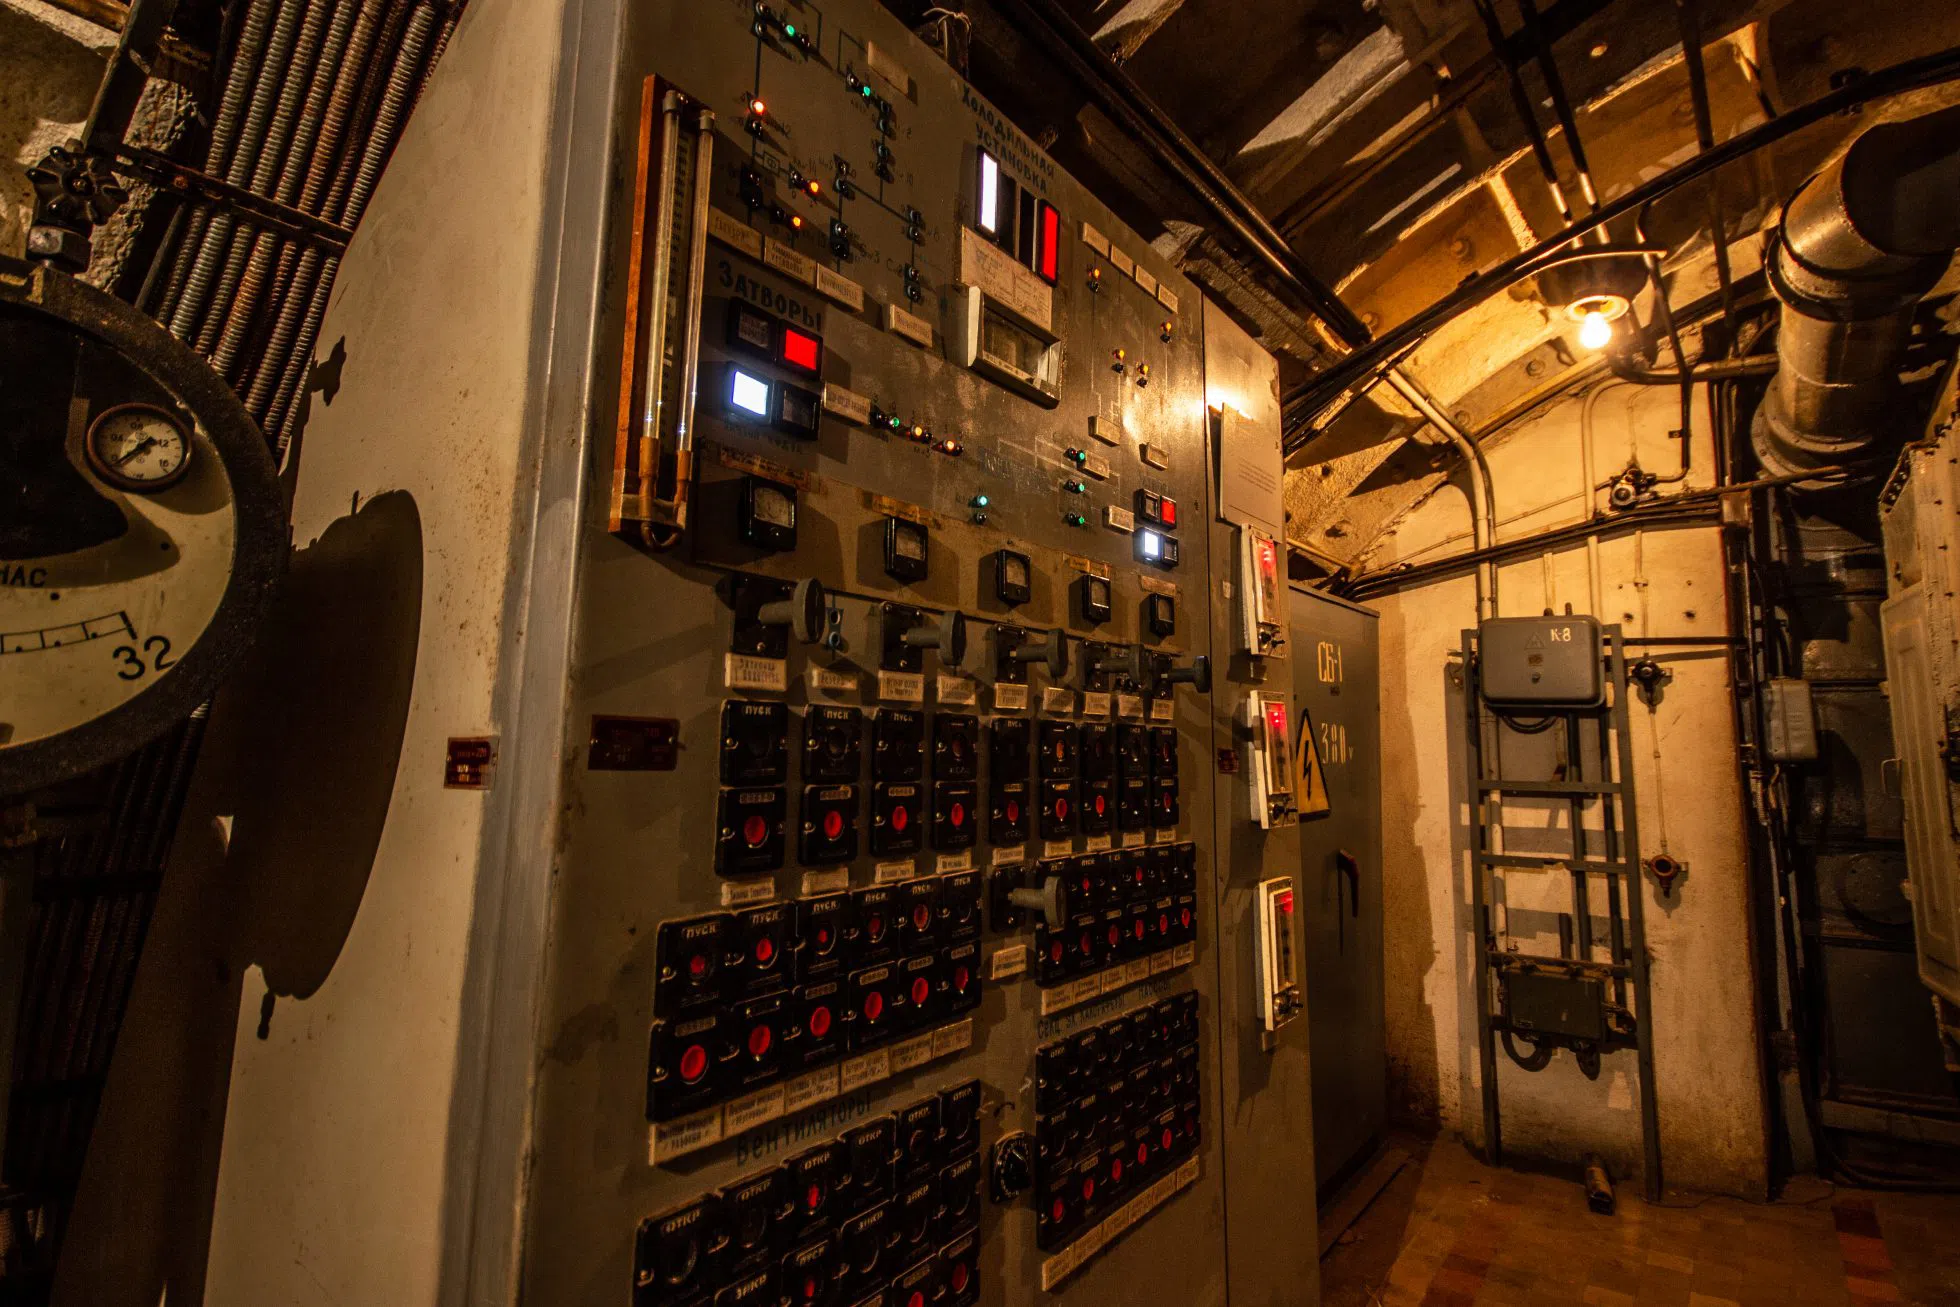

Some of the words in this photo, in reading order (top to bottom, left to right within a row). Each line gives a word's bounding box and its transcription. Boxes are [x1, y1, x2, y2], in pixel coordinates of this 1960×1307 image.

[962, 83, 1054, 180] ХОЛОДИЛЬНАЯ
[976, 121, 1046, 194] УСТАНОВКА
[718, 260, 821, 332] ЗАТВОРЫ
[112, 635, 177, 681] 32
[744, 705, 772, 716] ПУСК
[826, 710, 849, 720] ПУСК
[954, 876, 971, 887] ПУСК
[912, 884, 933, 895] ПУСК
[865, 892, 887, 903] ПУСК
[813, 901, 837, 912] ПУСК
[751, 910, 780, 923] ПУСК
[686, 925, 716, 938] ПУСК
[953, 1088, 972, 1101] ОТКР
[908, 1108, 931, 1122] ОТКР
[858, 1129, 883, 1145] ОТКР
[804, 1152, 831, 1170] ОТКР
[740, 1179, 772, 1201] ОТКР
[665, 1208, 701, 1233] ОТКР
